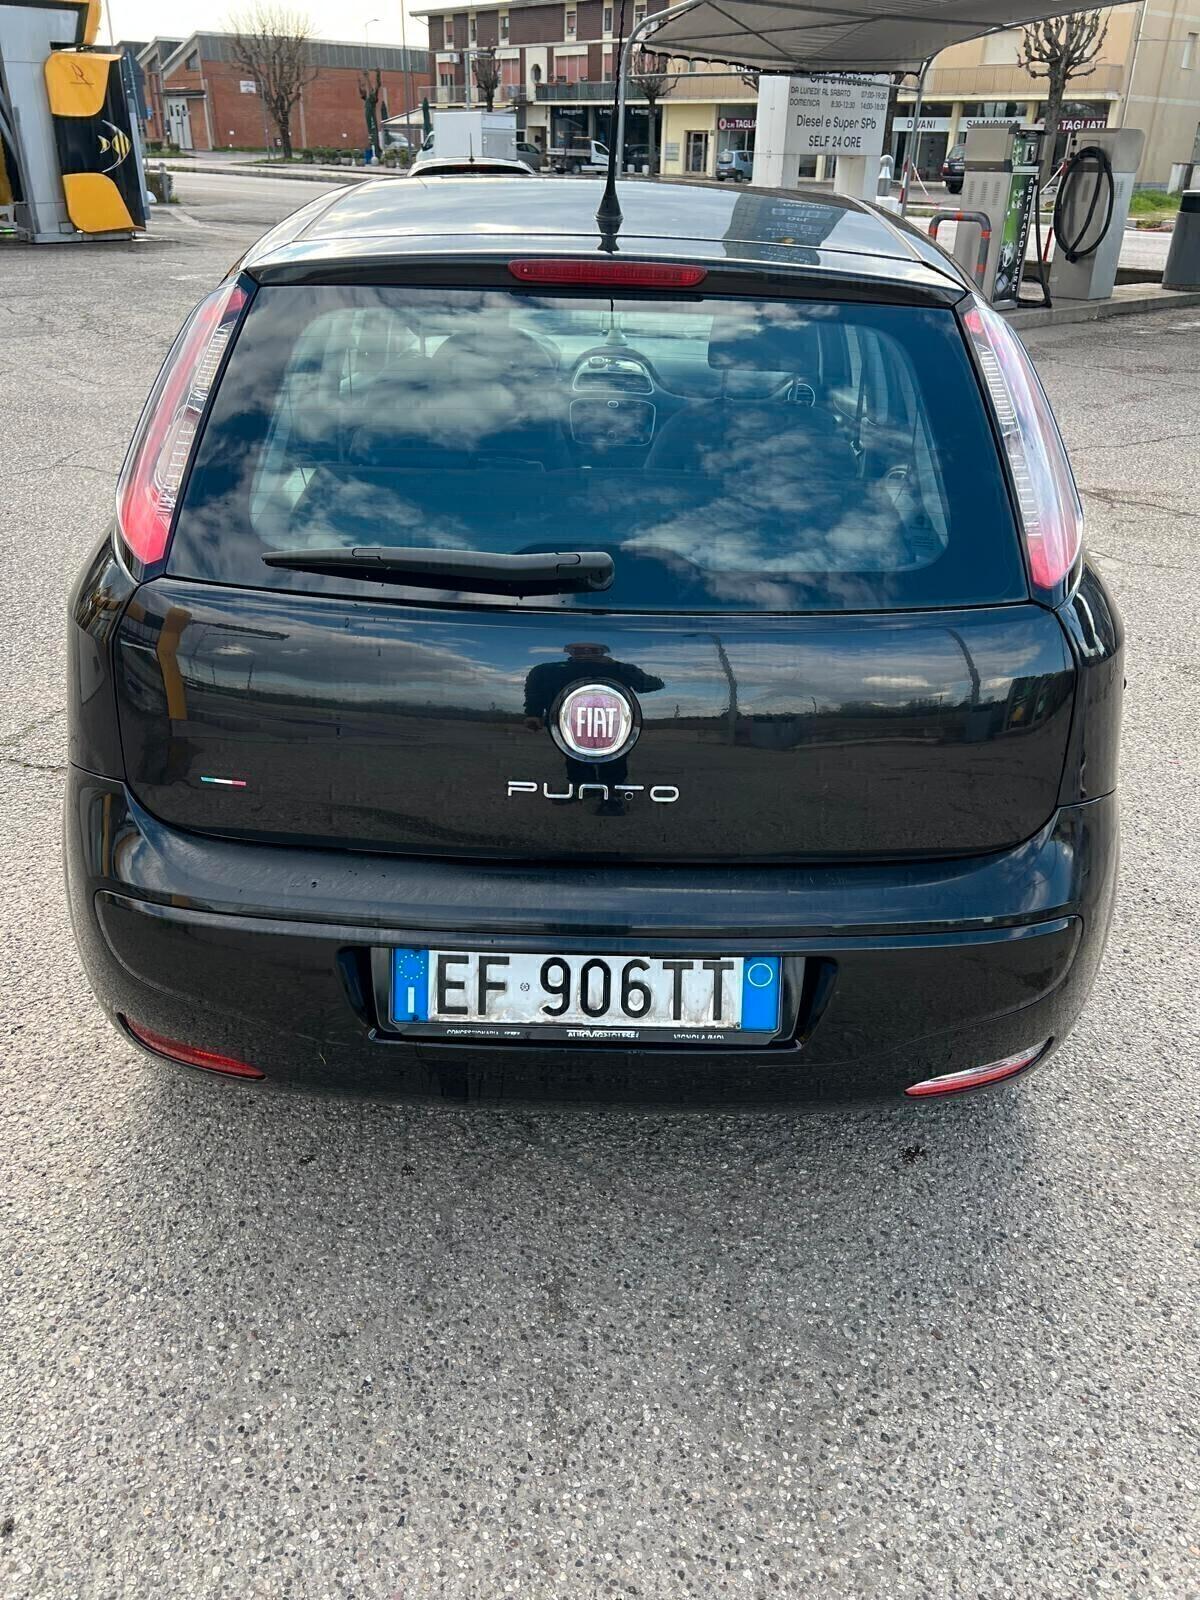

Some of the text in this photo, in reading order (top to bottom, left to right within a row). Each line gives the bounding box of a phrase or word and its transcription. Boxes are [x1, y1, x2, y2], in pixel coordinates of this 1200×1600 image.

[790, 86, 799, 94] DA
[821, 88, 829, 96] AL
[830, 88, 851, 98] SABATO
[789, 98, 820, 107] DOMENICA
[796, 114, 877, 131] Diesel e Super SPb
[808, 135, 862, 148] SELF 24 ORE
[1012, 177, 1034, 292] ASPIRAPOLVERE
[576, 706, 617, 738] FIAT
[507, 780, 680, 802] PUNTO
[437, 953, 735, 1021] EF 906TT
